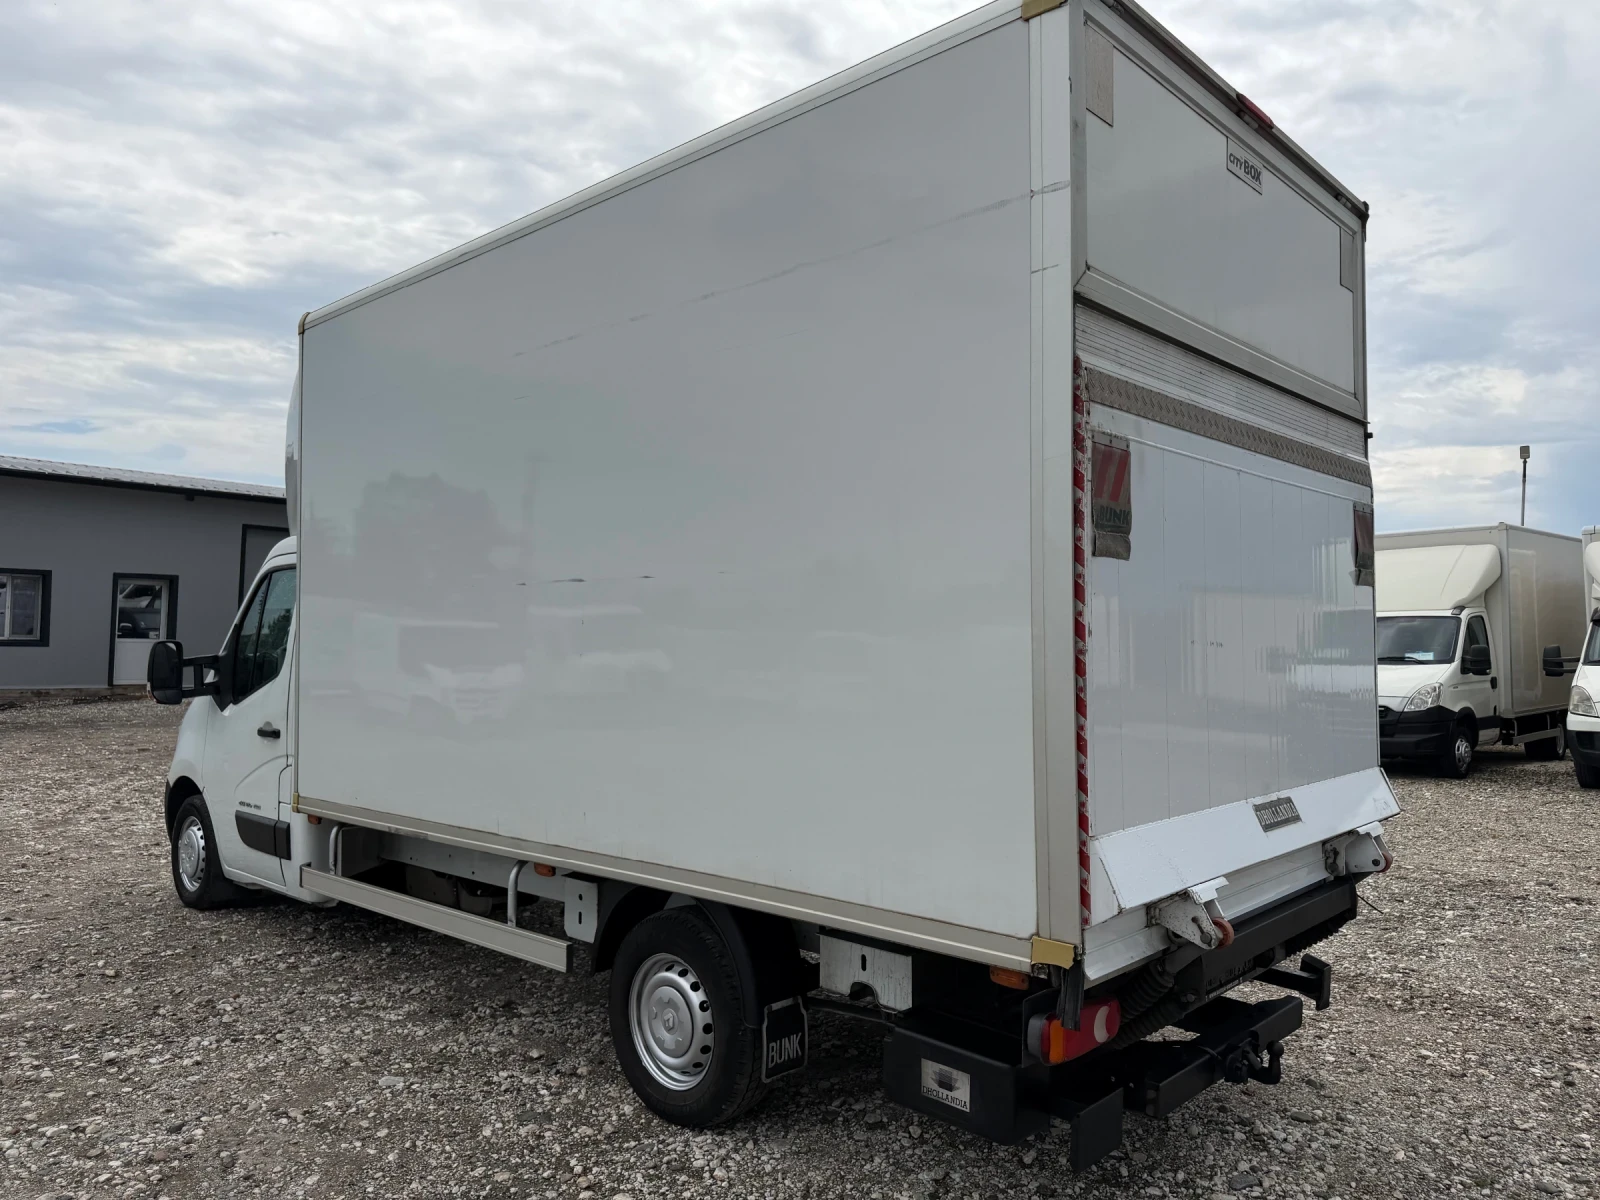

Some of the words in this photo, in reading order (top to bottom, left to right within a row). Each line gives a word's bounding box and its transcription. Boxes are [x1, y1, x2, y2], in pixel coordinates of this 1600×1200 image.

[1243, 158, 1262, 185] BOX
[1099, 505, 1131, 526] BUNK
[1256, 802, 1299, 825] DHOLLANDIA
[768, 1032, 802, 1069] BUNK
[922, 1085, 968, 1110] DHOLLANDIA
